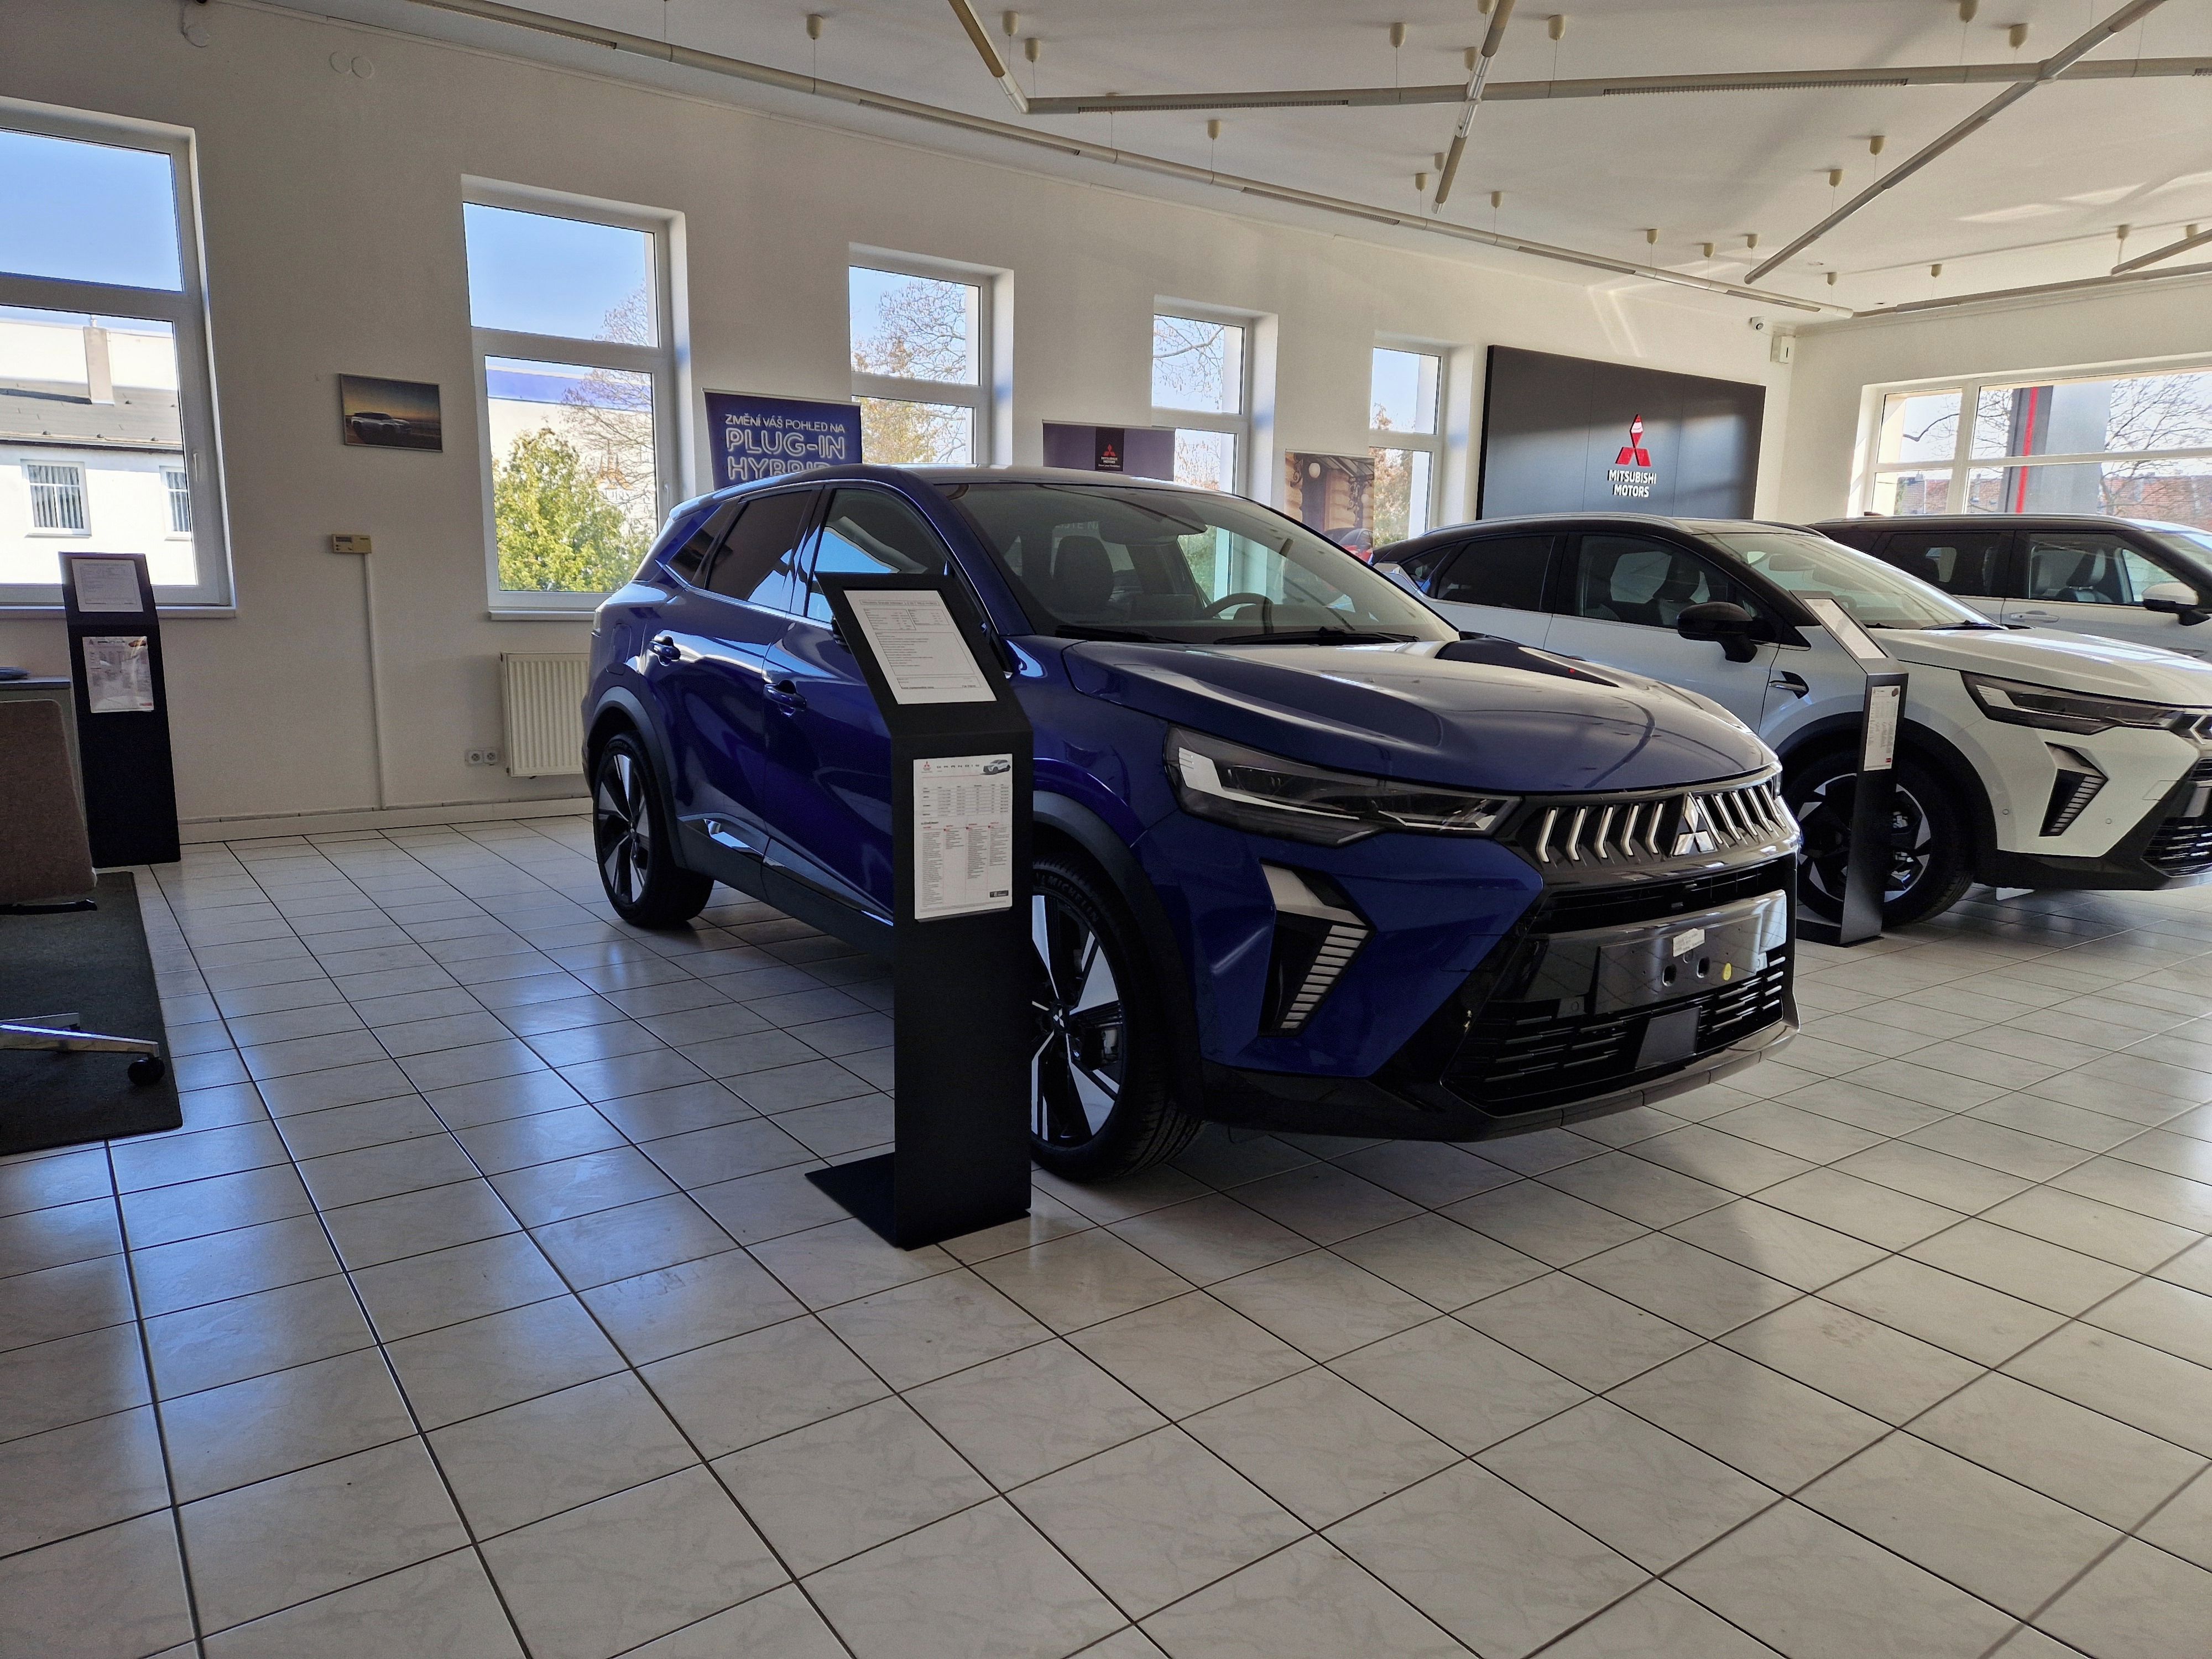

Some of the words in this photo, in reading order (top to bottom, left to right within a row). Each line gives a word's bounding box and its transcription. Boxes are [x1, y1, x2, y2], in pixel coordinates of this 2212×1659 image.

[725, 413, 761, 426] ZMĚNÍ
[763, 415, 782, 428] VÁŠ
[785, 420, 827, 432] POHLED
[830, 423, 845, 433] NA
[726, 427, 845, 460] PLUG-IN
[1608, 469, 1657, 484] MITSUBISHI
[1613, 484, 1650, 497] MOTORS
